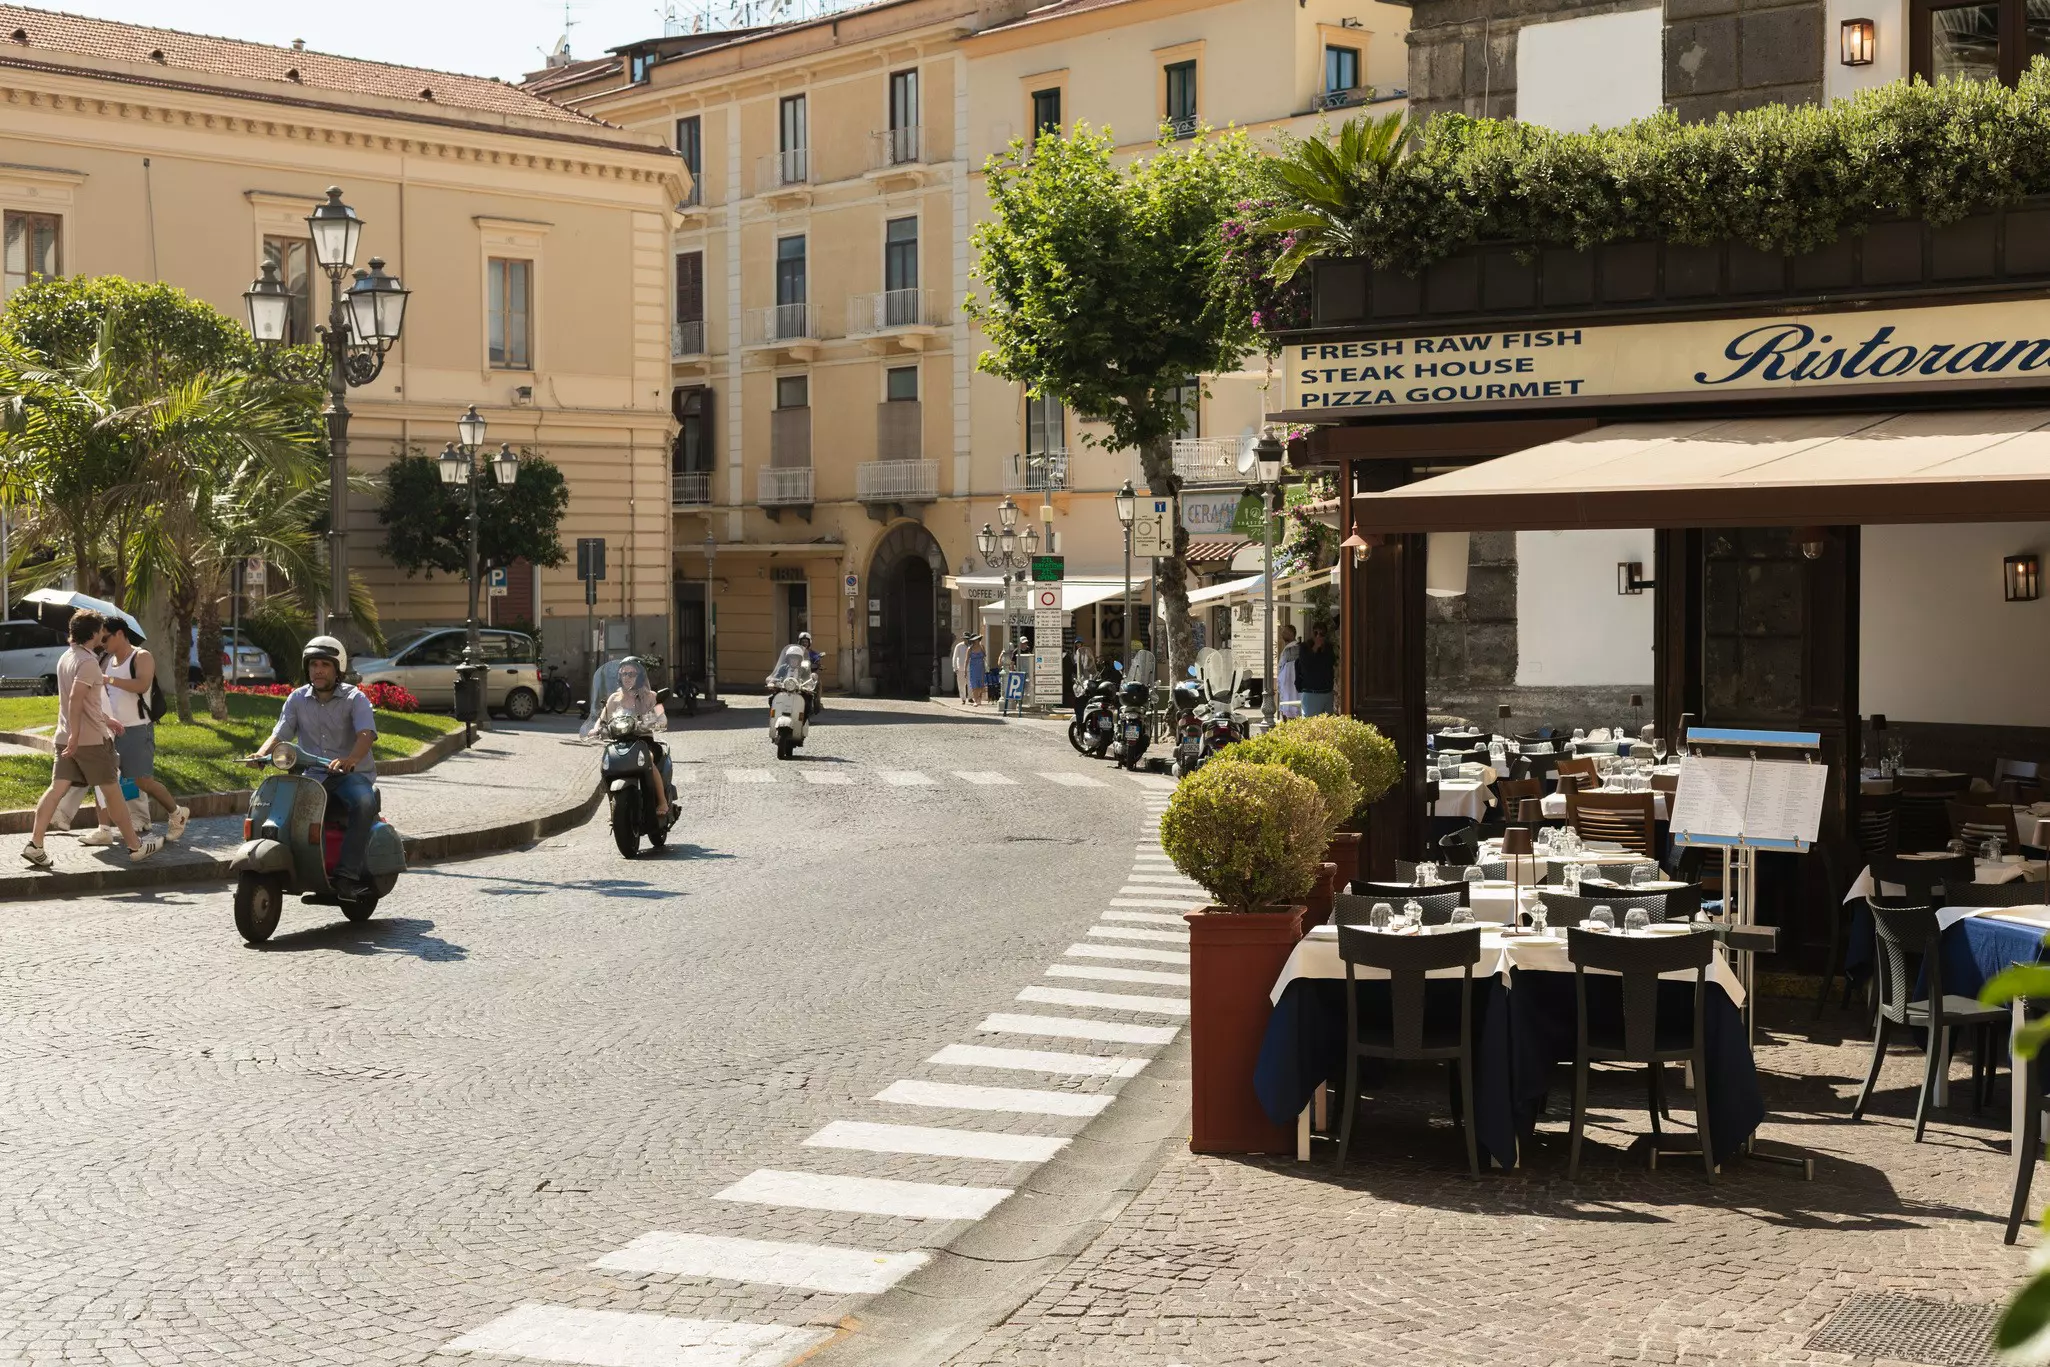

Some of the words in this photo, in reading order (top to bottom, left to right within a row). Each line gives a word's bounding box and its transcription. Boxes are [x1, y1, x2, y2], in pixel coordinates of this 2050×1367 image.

[1301, 340, 1403, 360] FRESH
[1414, 335, 1493, 354] RAW
[1502, 330, 1582, 349] FISH
[1301, 364, 1404, 383] STEAK
[1415, 357, 1534, 378] HOUSE
[1301, 389, 1396, 407] PIZZA
[1406, 379, 1584, 402] GOURMET
[492, 570, 504, 586] P
[968, 588, 992, 599] COFFEE
[1009, 675, 1021, 696] P
